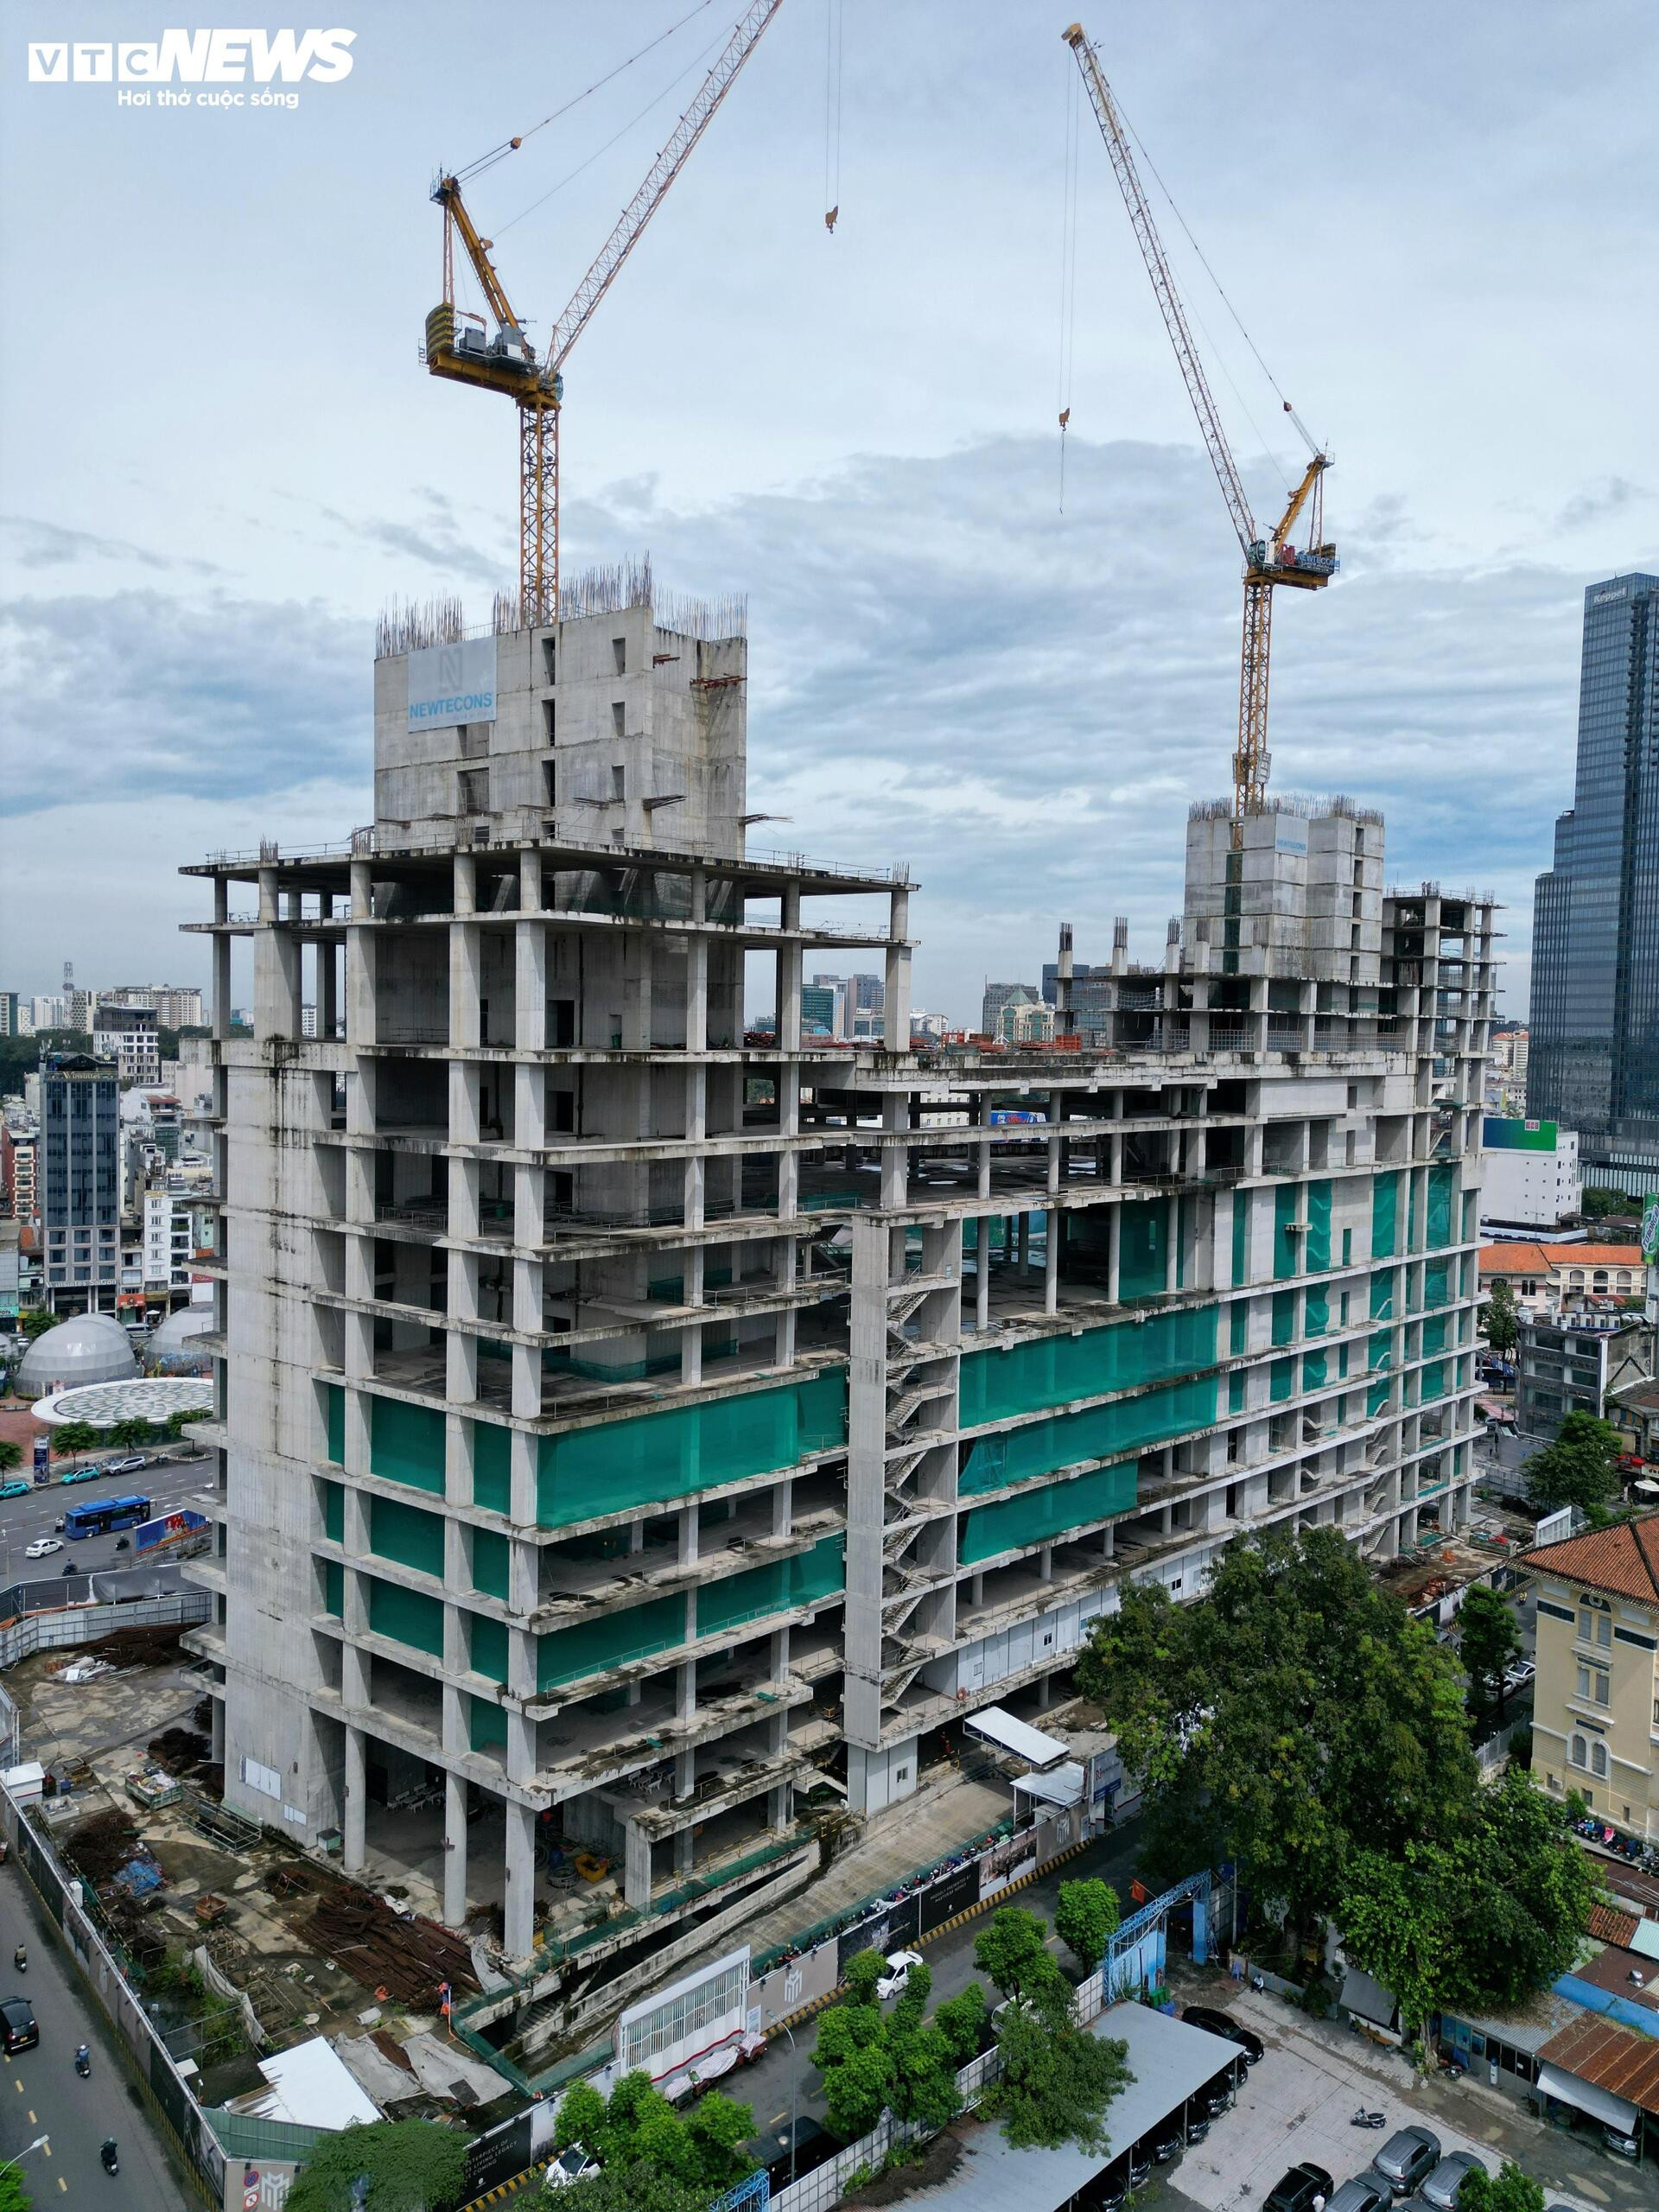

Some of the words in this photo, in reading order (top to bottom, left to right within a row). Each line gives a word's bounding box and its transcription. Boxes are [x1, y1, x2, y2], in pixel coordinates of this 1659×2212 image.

[1593, 587, 1627, 603] Keppel
[410, 692, 493, 719] NEWTECONS
[1643, 1215, 1658, 1248] TUBORG
[473, 2158, 497, 2176] COMING
[474, 2154, 493, 2169] LIVING
[495, 2139, 518, 2157] LEGACY
